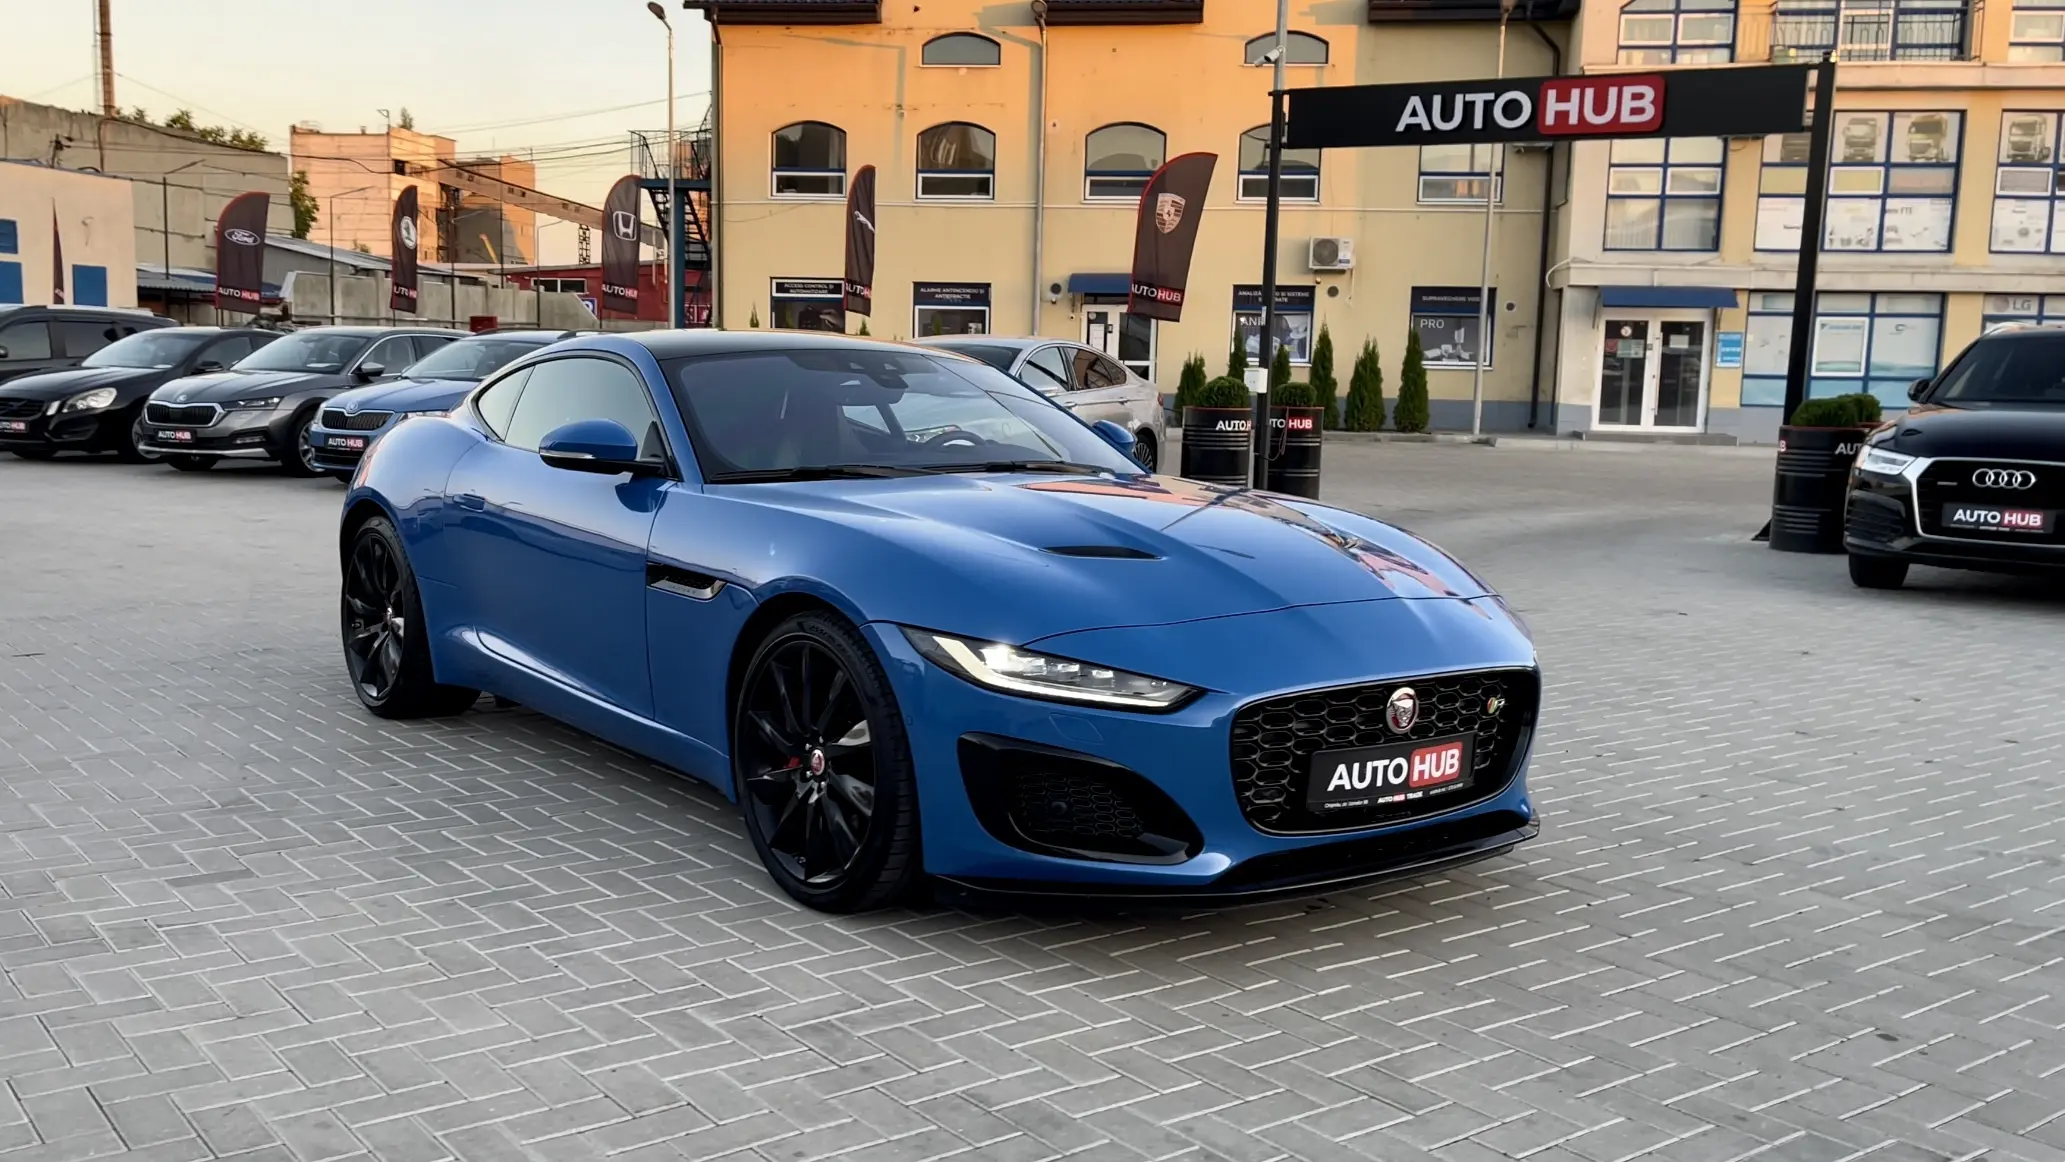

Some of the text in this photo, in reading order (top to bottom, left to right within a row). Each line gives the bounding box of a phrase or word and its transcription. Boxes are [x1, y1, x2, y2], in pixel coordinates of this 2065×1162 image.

[1395, 84, 1657, 133] AUTO HUB
[218, 286, 260, 301] AUTO HUB
[1157, 288, 1182, 303] HUB
[2012, 299, 2033, 312] LG
[1420, 318, 1445, 329] PRO
[1288, 419, 1313, 429] HUB
[158, 430, 191, 440] AUTO HUB
[328, 437, 364, 448] AUTO HUB
[1953, 508, 2043, 527] AUTO HUB
[1327, 748, 1460, 791] AUTO HUB
